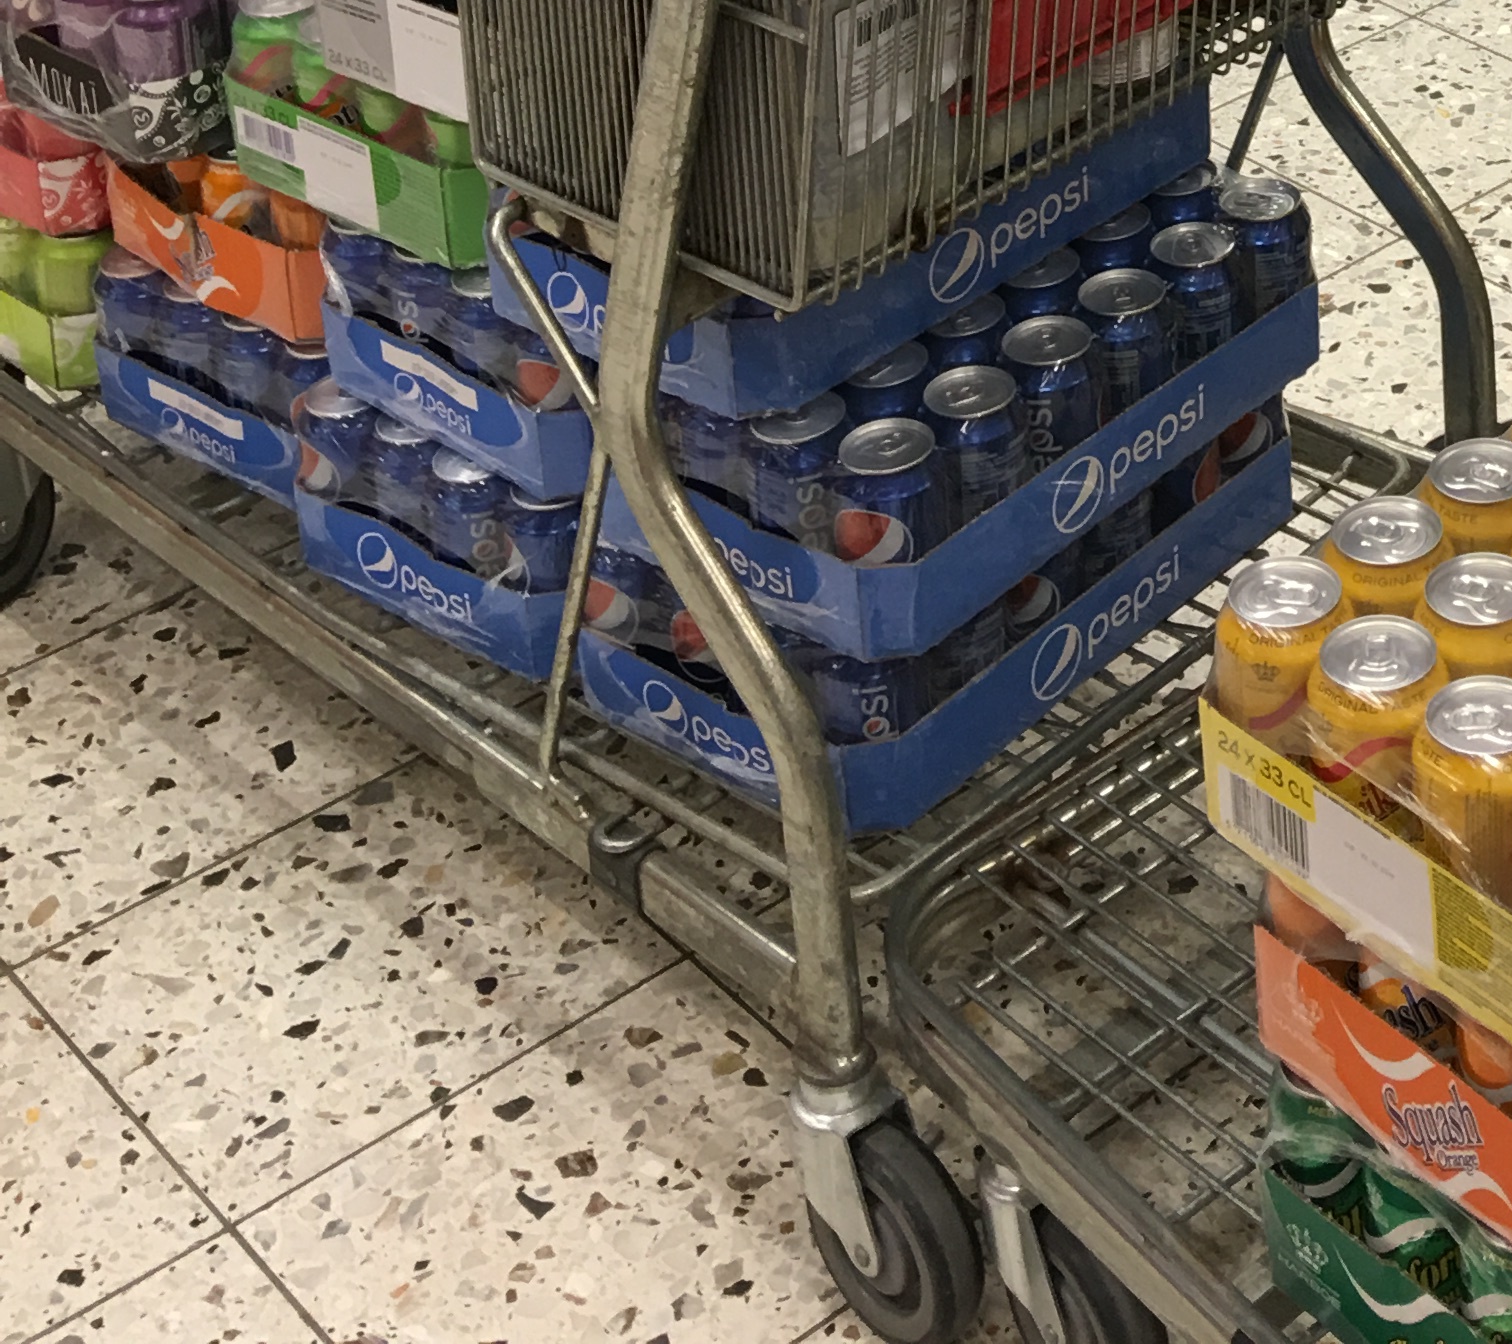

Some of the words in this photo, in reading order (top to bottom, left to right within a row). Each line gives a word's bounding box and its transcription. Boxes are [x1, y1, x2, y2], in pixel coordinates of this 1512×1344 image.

[980, 167, 1092, 268] pepsi
[190, 418, 236, 466] pepsi
[421, 393, 472, 437] pepsi
[1101, 384, 1208, 494] pepsi
[400, 567, 472, 623] pepsi
[1085, 544, 1182, 661] pepsi
[1216, 730, 1242, 759] 24
[1260, 759, 1286, 787] 33
[1288, 779, 1312, 809] CL
[1382, 1080, 1484, 1174] Squash
[1436, 1150, 1479, 1177] Orange
